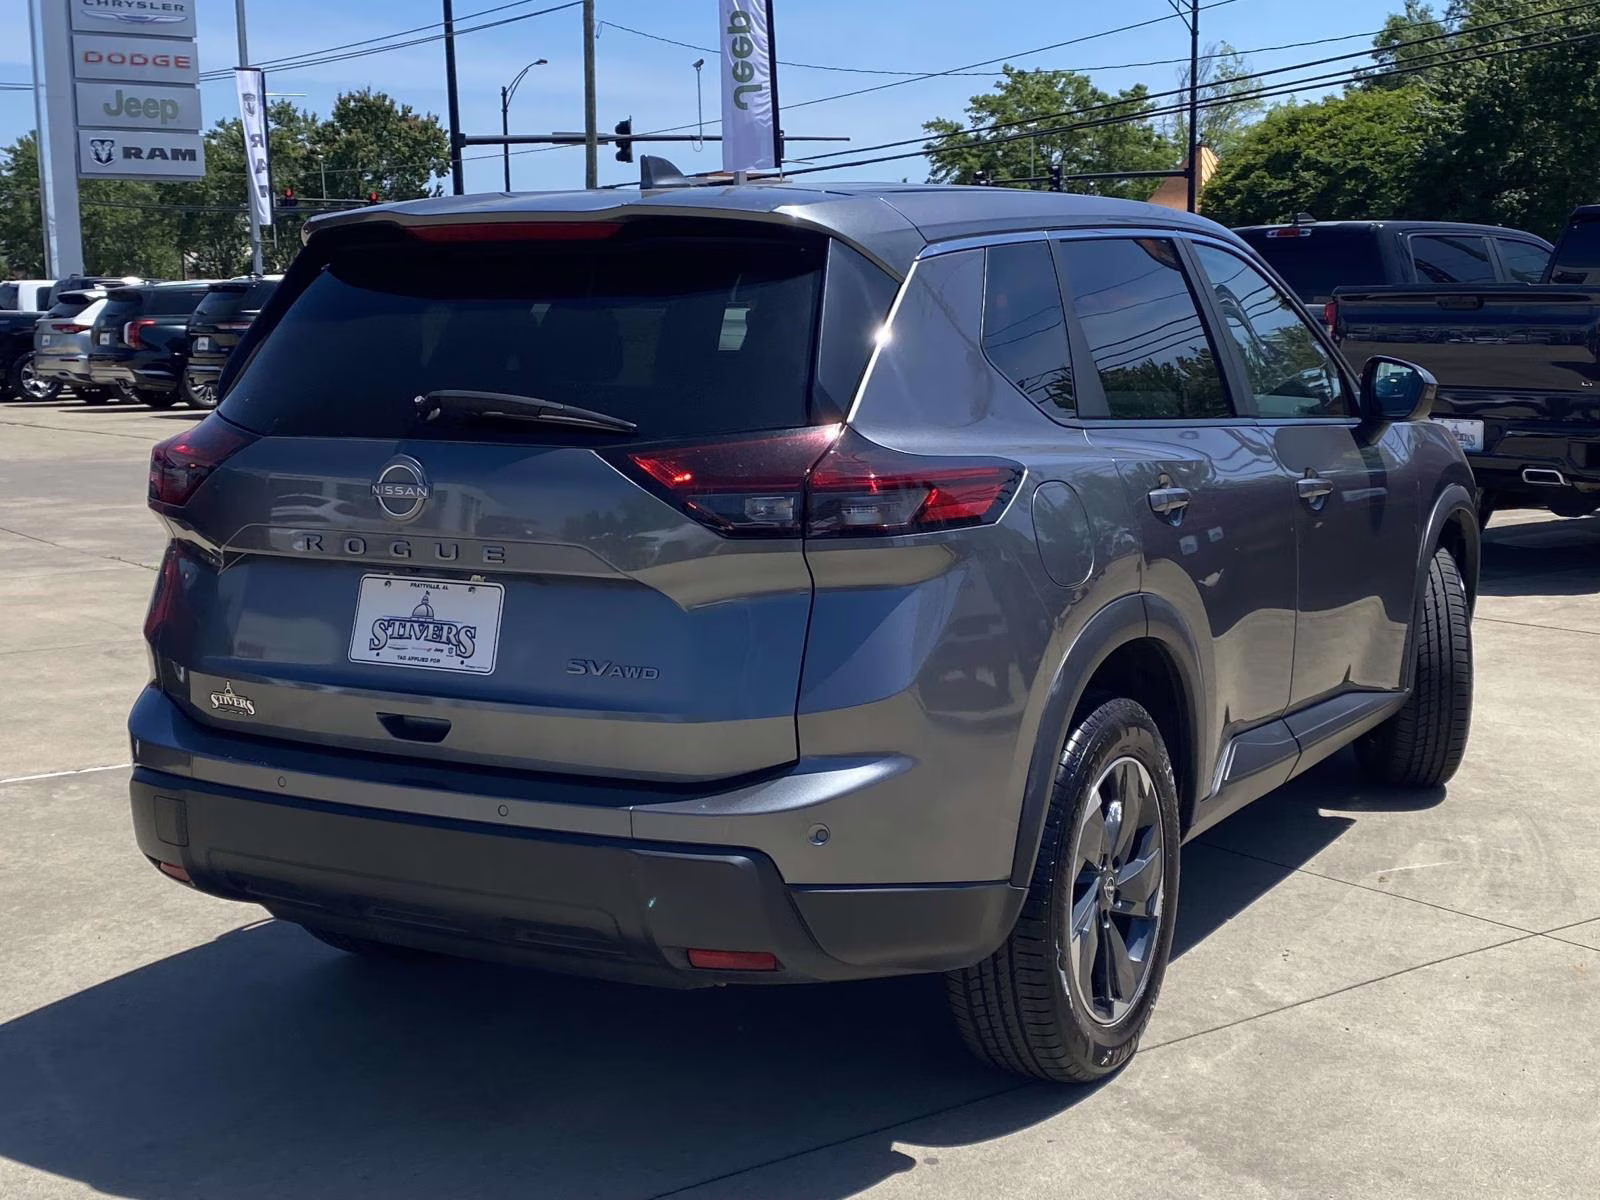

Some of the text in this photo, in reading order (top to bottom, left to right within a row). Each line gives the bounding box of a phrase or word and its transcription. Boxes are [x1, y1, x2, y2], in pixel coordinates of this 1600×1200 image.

[82, 0, 185, 12] CHRYSLER
[83, 50, 191, 69] DODGE
[103, 89, 180, 124] Jeep
[122, 146, 197, 162] RAM
[371, 484, 428, 497] NISSAN
[303, 533, 505, 565] ROGUE
[369, 618, 477, 659] STIVERS
[210, 693, 256, 715] STIVERS
